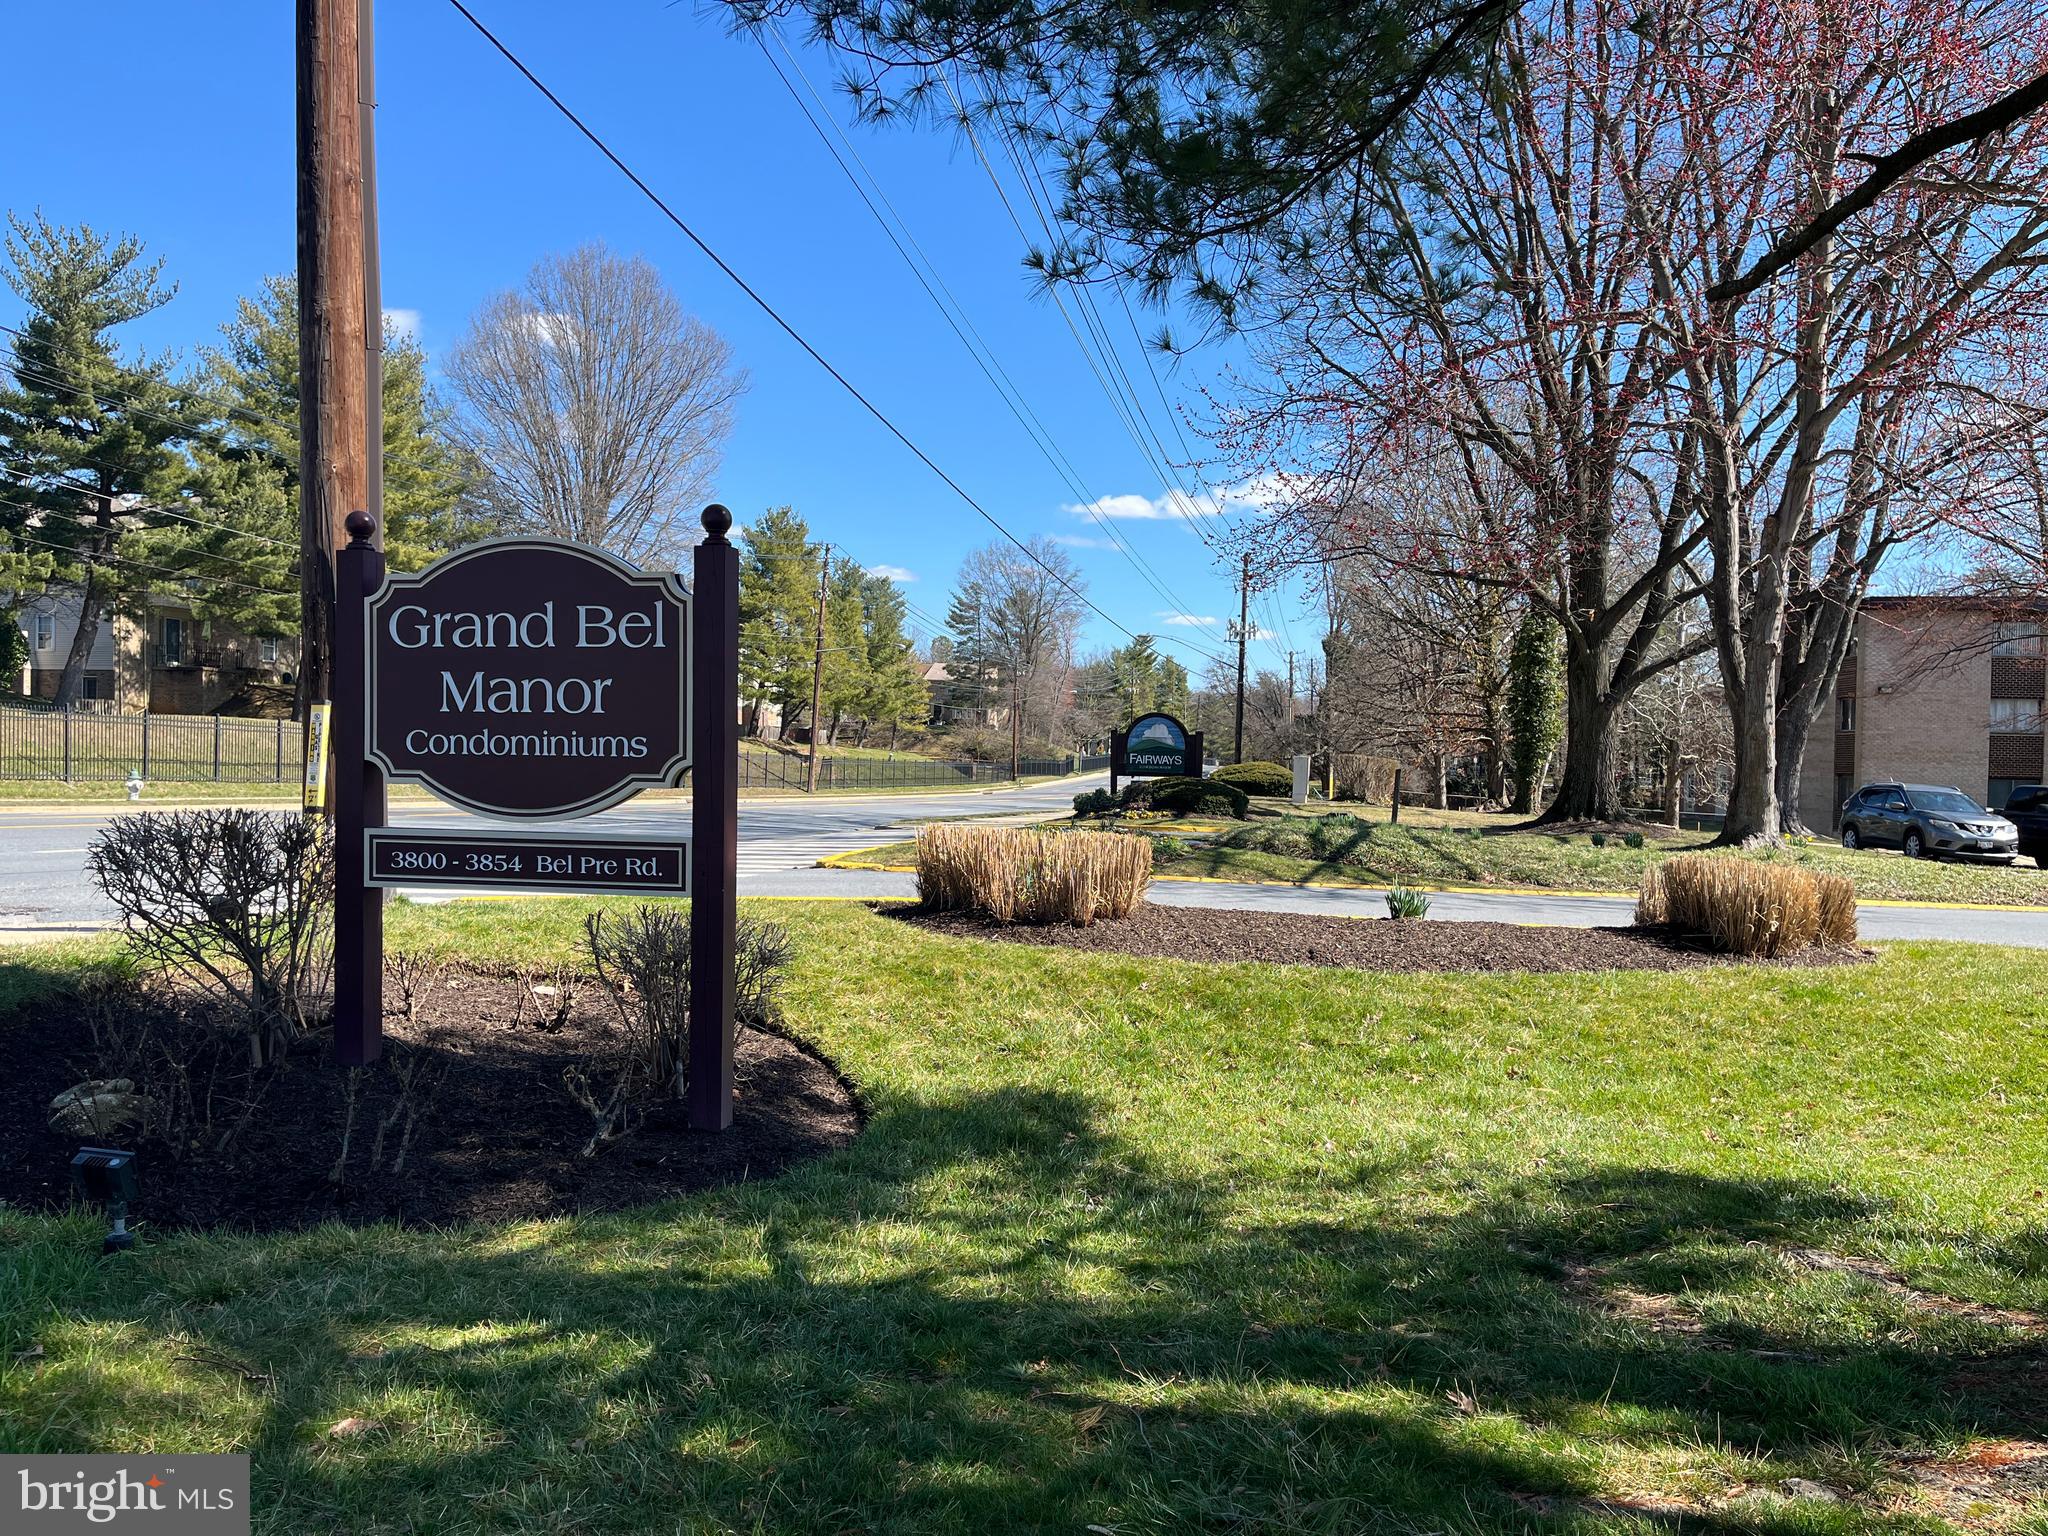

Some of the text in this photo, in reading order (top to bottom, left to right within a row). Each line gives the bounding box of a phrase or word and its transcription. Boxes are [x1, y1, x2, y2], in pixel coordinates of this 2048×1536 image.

[388, 600, 667, 649] Grand Bel
[439, 671, 613, 714] Manor
[405, 728, 648, 758] Condominiums
[1129, 753, 1182, 765] FAIRWAYS
[391, 851, 447, 869] 3800
[465, 853, 523, 872] 3854
[536, 854, 573, 874] Bel
[580, 856, 618, 875] Pre
[625, 857, 662, 876] Rd.
